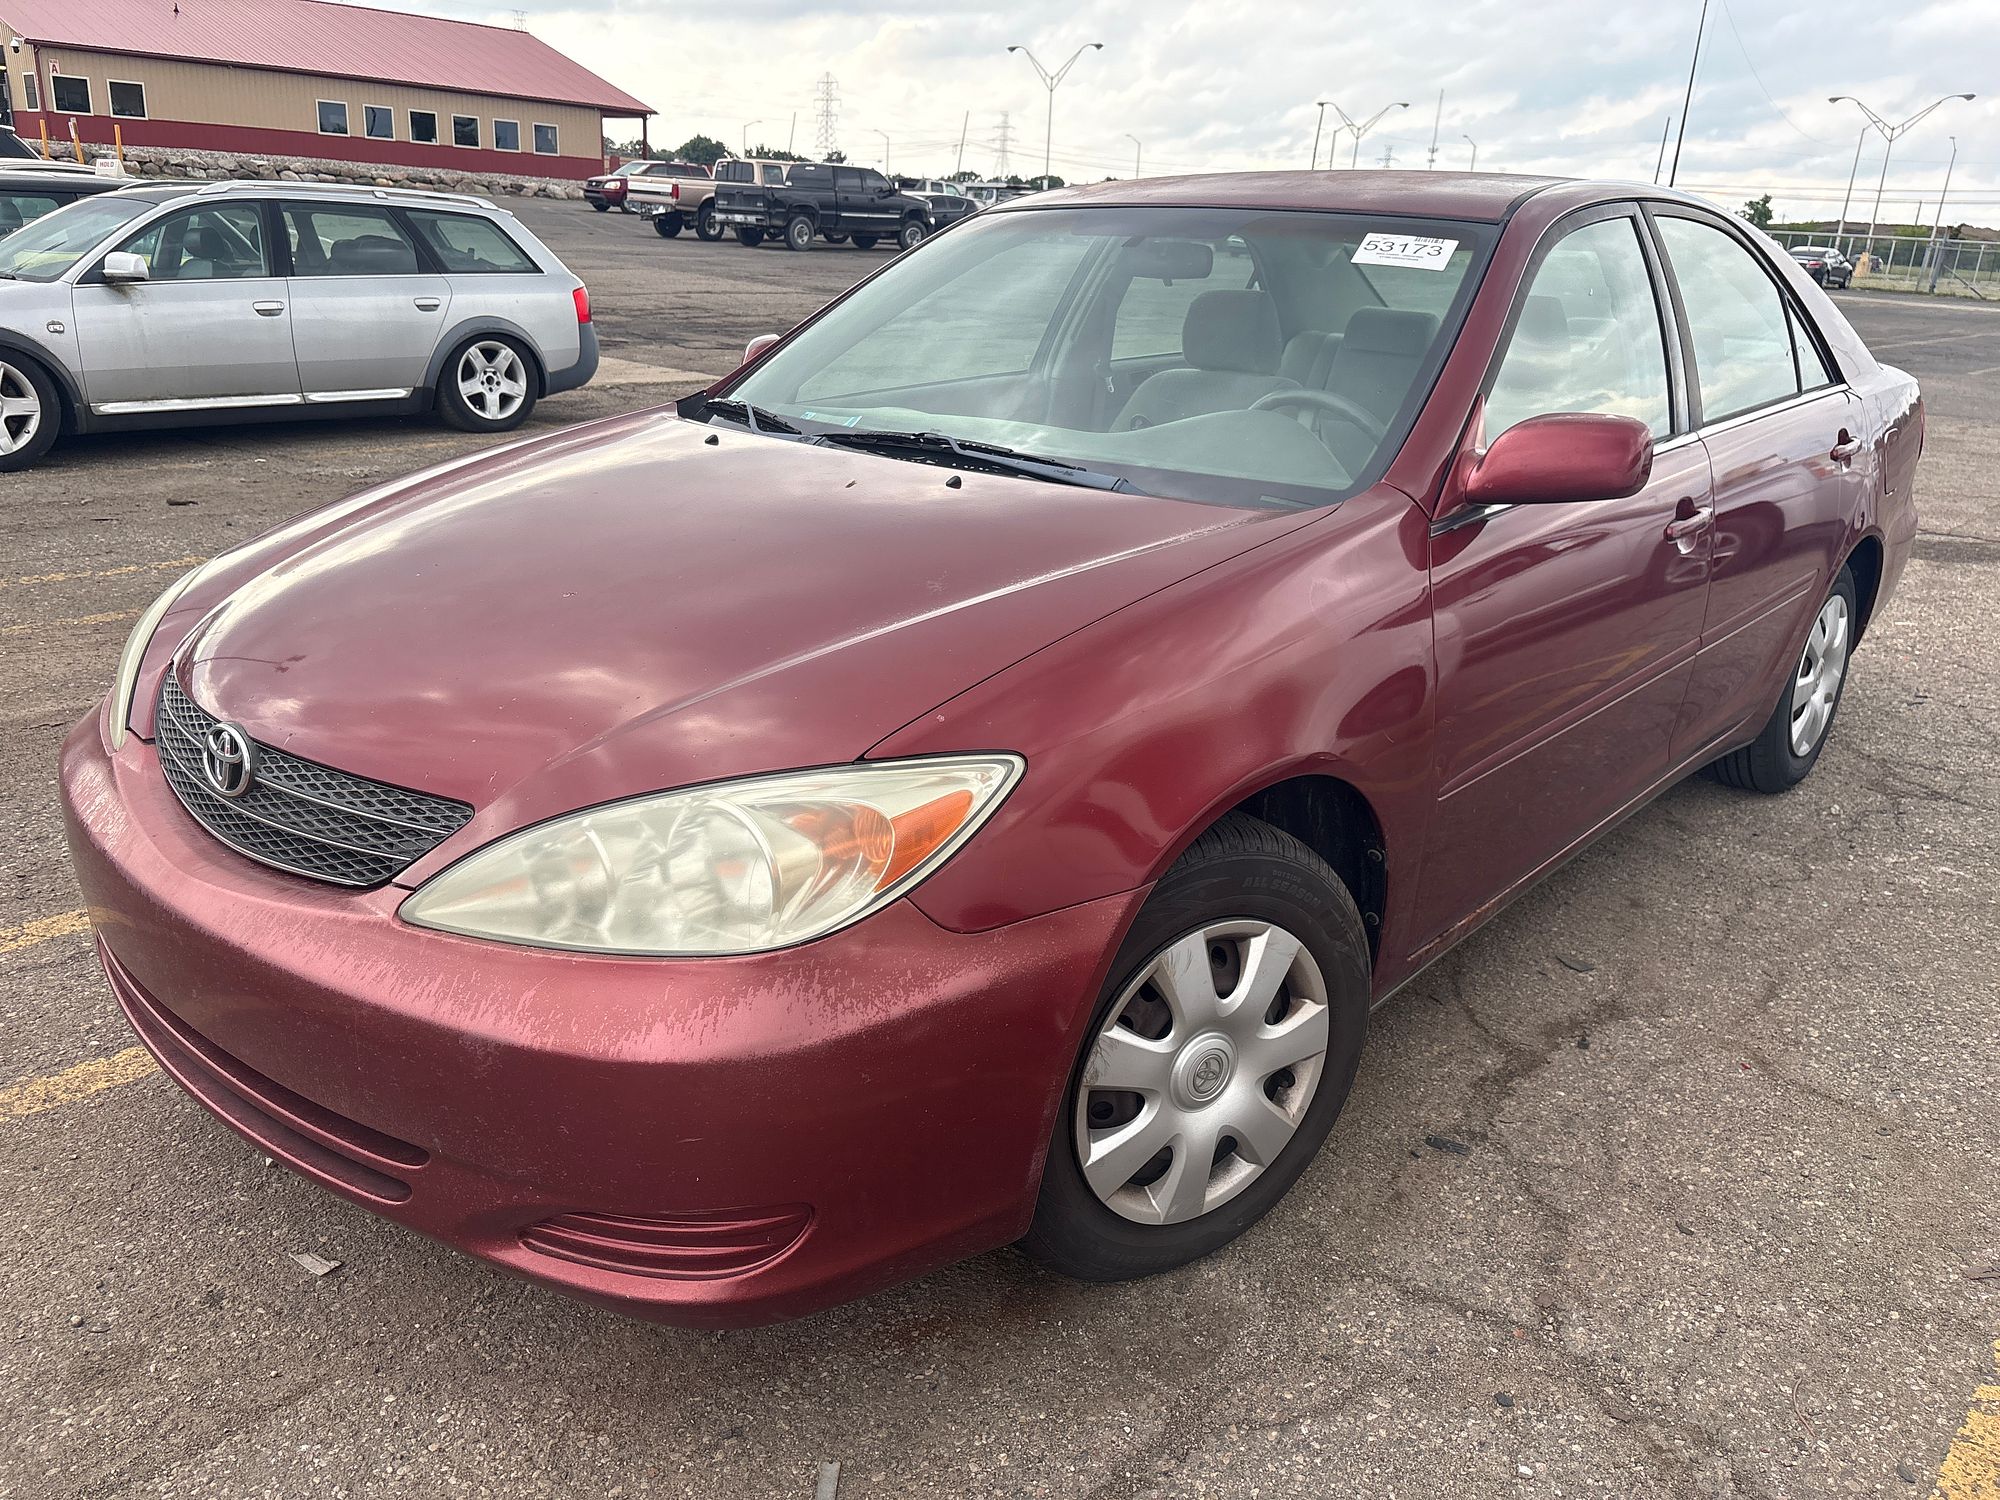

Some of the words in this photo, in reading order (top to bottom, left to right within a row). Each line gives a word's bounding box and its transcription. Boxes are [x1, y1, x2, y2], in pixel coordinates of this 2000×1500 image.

[51, 63, 58, 74] A
[1363, 240, 1443, 257] 53173
[1241, 876, 1268, 888] ALL
[1270, 879, 1321, 907] SEASON
